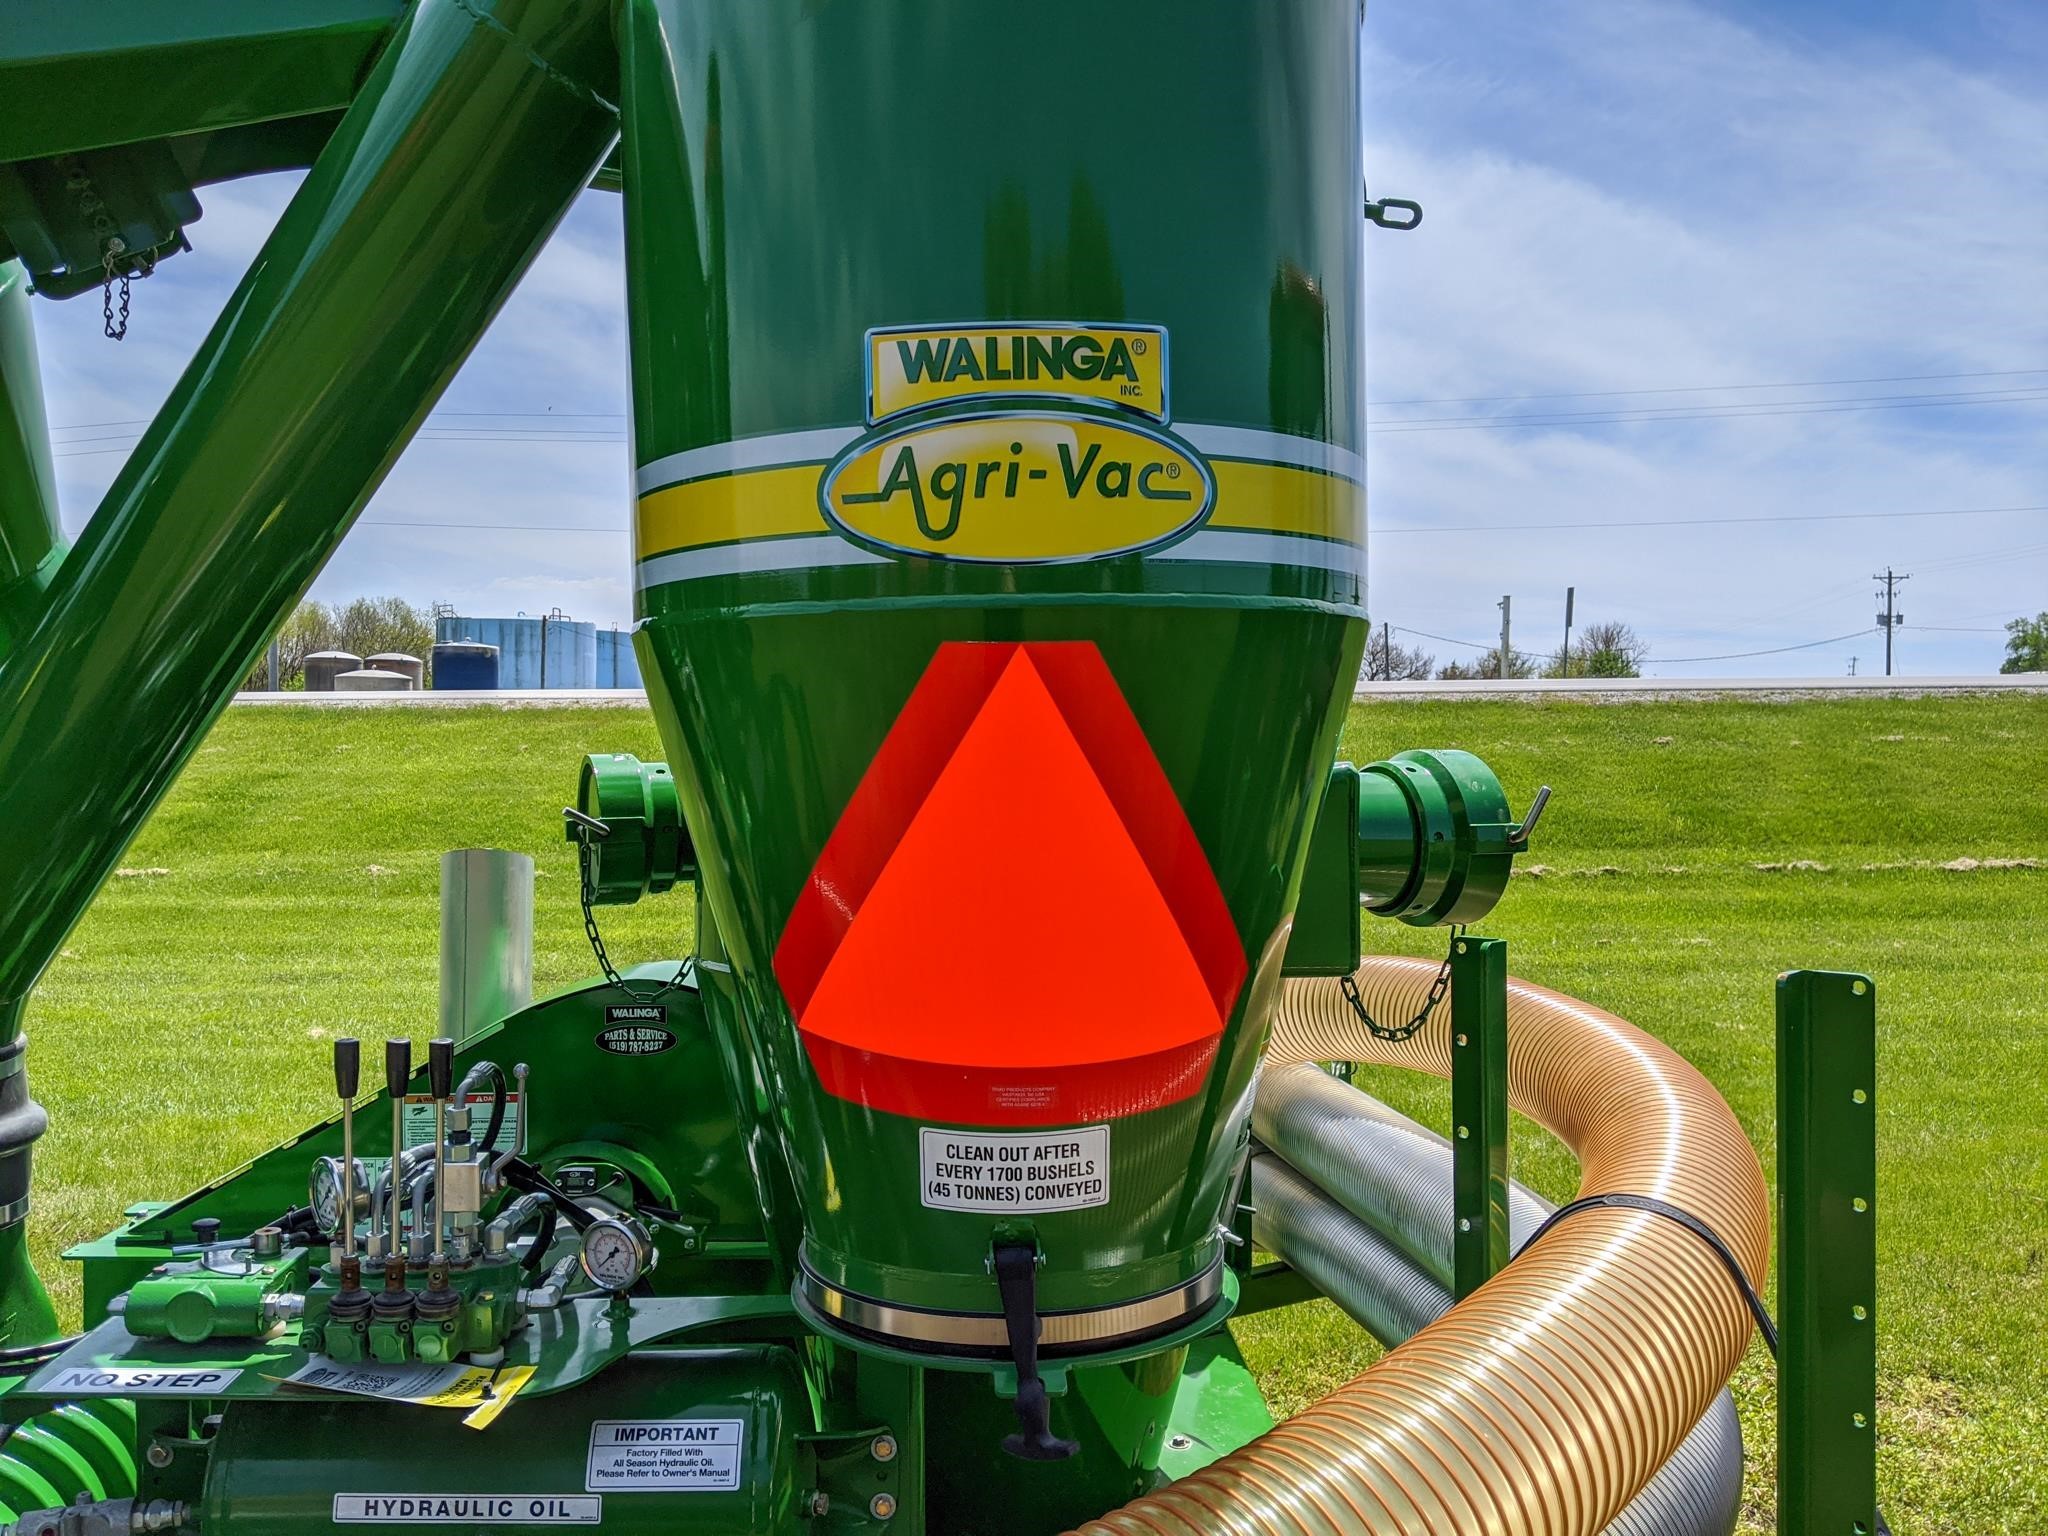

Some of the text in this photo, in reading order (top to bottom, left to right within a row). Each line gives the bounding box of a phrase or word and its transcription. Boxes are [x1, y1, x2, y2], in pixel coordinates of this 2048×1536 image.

[1120, 384, 1143, 397] INC.
[604, 1028, 667, 1040] PARTS & SERVICE
[609, 1041, 627, 1052] (519)
[946, 1143, 1080, 1162] CLEAN OUT AFTER
[936, 1160, 1095, 1182] EVERY 1700 BUSHELS
[928, 1179, 1102, 1205] (45 TONNES) CONVEYED
[60, 1373, 222, 1388] NO STEP
[614, 1427, 720, 1442] IMPORTANT
[626, 1449, 703, 1459] Factory Filled With
[613, 1458, 714, 1469] All Season Hydraulic Oil.
[596, 1469, 625, 1478] Please
[626, 1469, 650, 1477] Refer
[662, 1469, 697, 1478] Owner's
[699, 1468, 730, 1477] Manual
[364, 1499, 571, 1517] HYDRAULIC OIL
